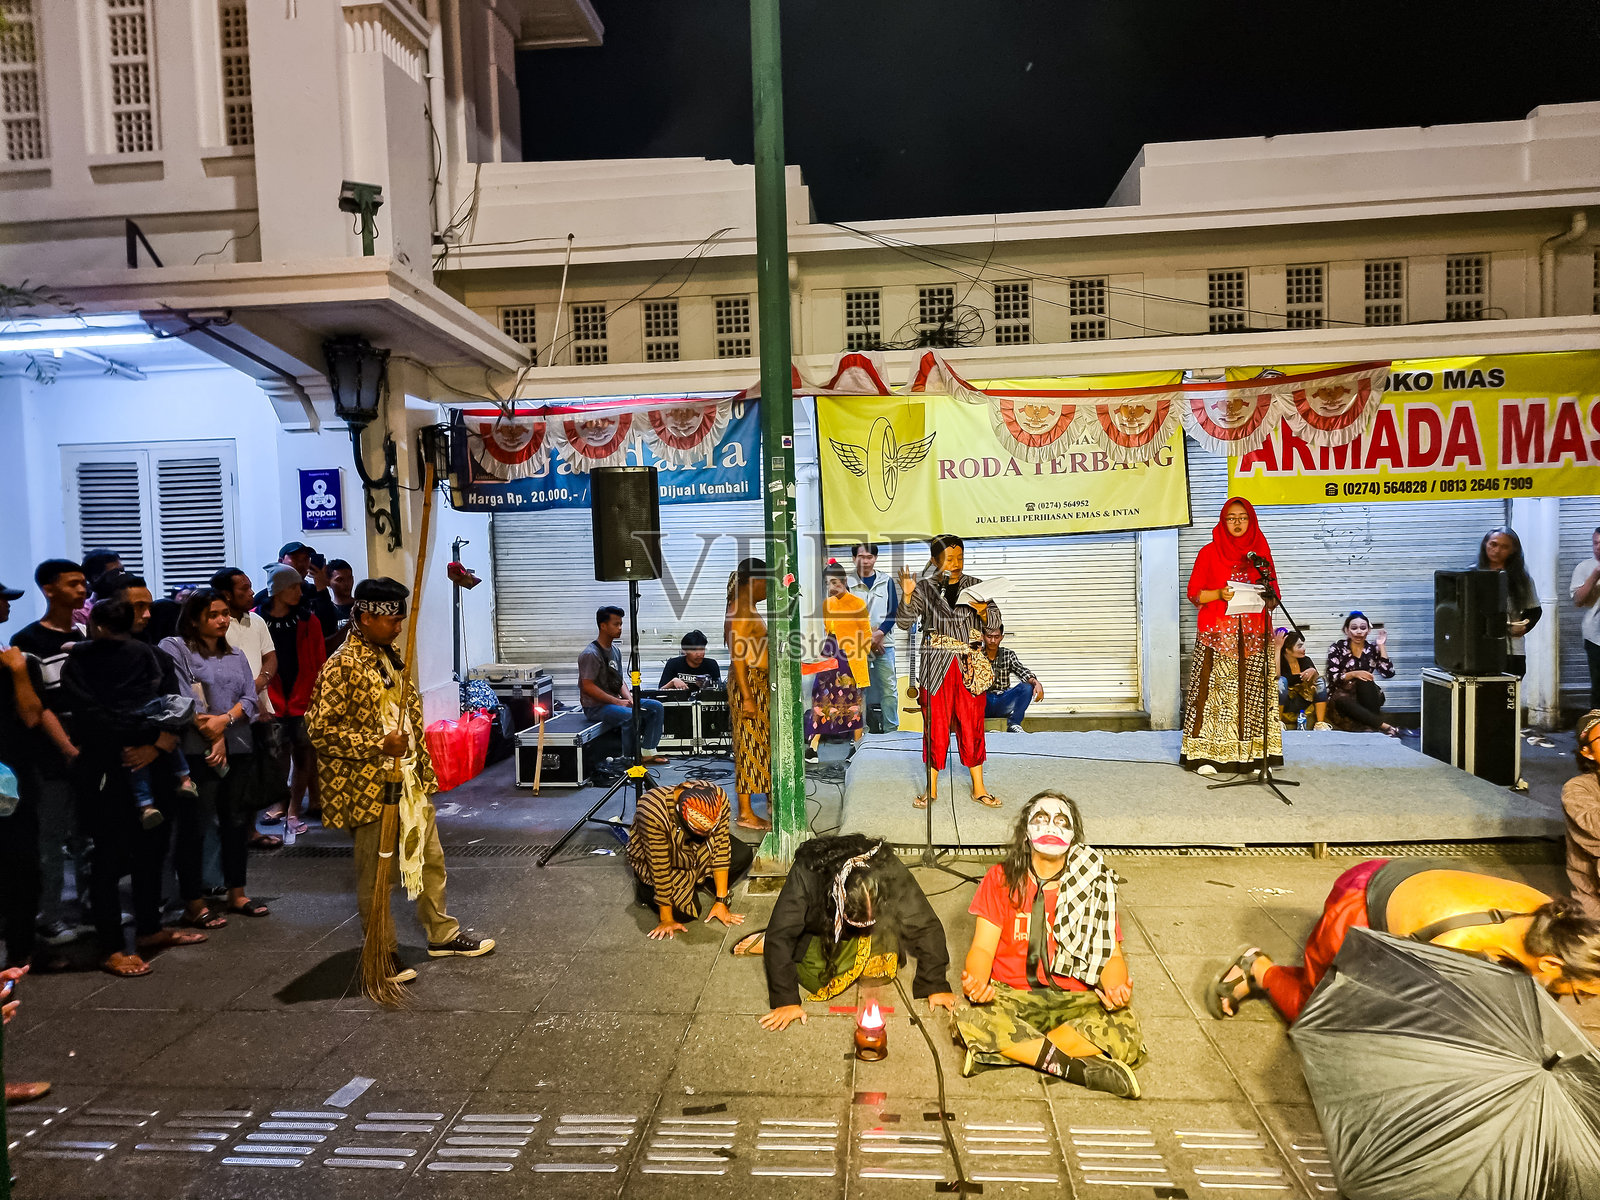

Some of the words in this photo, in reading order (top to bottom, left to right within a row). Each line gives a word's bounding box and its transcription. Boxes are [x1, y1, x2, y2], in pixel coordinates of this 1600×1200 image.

[1443, 368, 1505, 390] MAS
[1501, 401, 1600, 465] MA
[937, 456, 1023, 480] RODA
[468, 492, 504, 506] Harga
[507, 492, 527, 506] Rp.
[531, 488, 579, 503] 20.000,-
[660, 483, 695, 499] Dijual
[699, 480, 749, 495] Kembali
[1343, 482, 1381, 496] (0274)
[1383, 480, 1427, 494] 564828
[1430, 480, 1436, 493] /
[1439, 479, 1467, 493] 0813
[1470, 478, 1500, 492] 2646
[1503, 477, 1533, 490] 7909
[307, 510, 337, 518] propan
[1037, 502, 1061, 511] (0274)
[1063, 500, 1089, 509] 564952
[976, 516, 998, 524] JUAL
[1000, 515, 1020, 523] BELI
[1022, 512, 1074, 522] PERHIASAN
[1075, 510, 1101, 519] EMAS
[1112, 508, 1140, 517] INTAN
